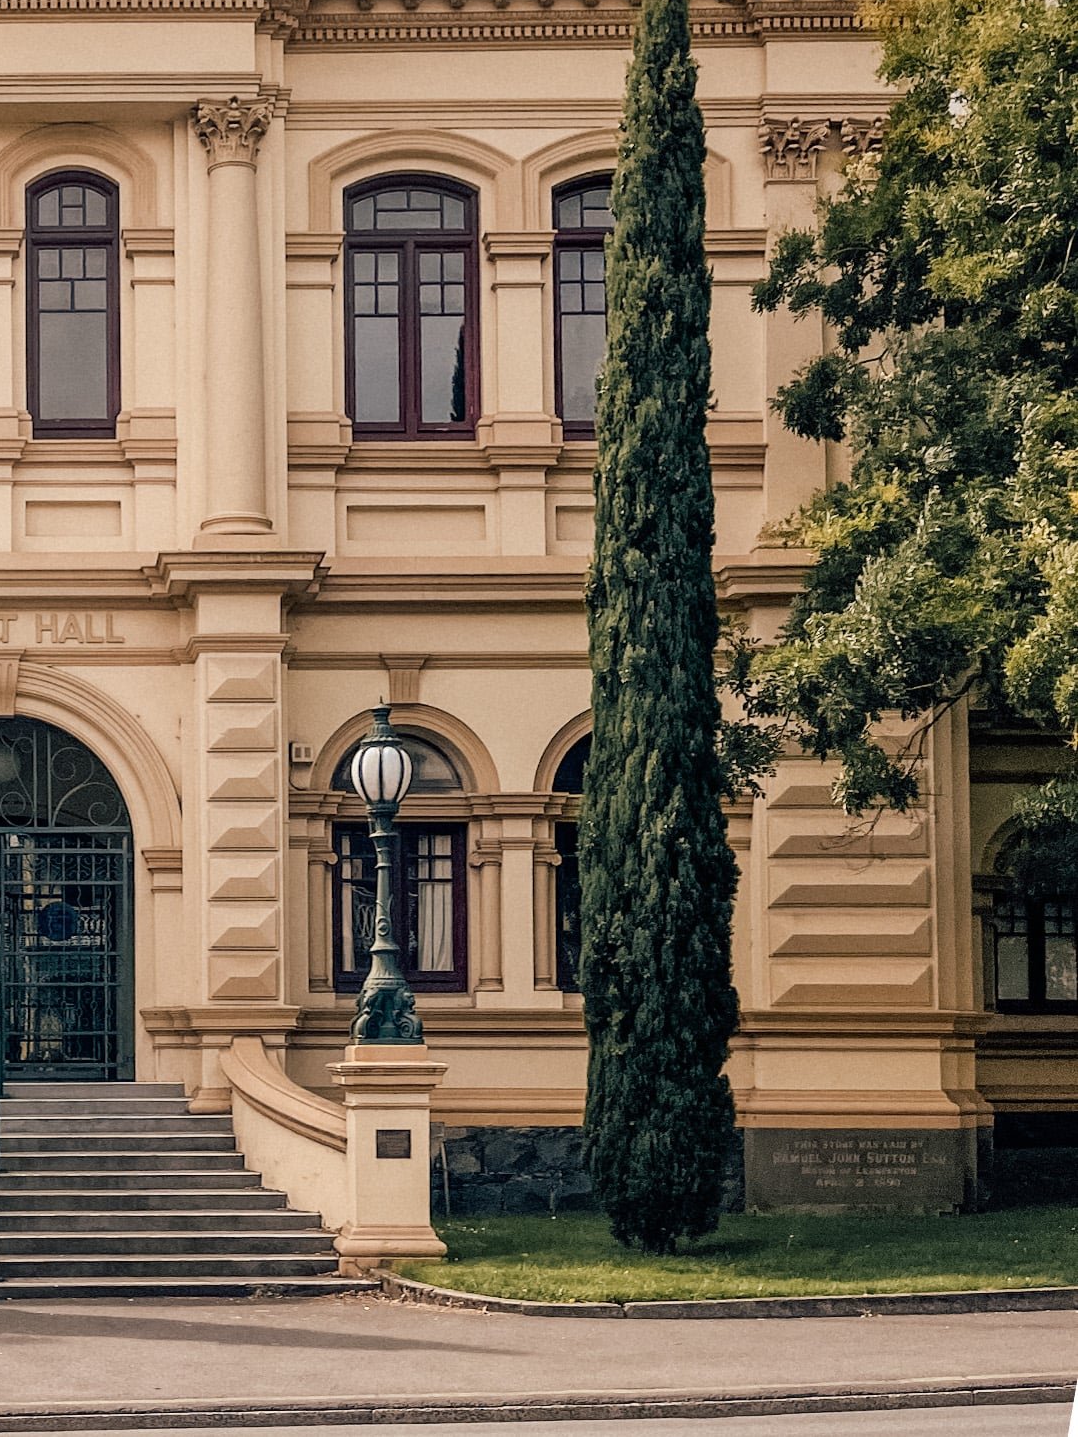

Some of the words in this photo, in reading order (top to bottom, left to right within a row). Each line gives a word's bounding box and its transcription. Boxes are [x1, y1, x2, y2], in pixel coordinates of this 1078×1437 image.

[35, 613, 126, 644] HALL
[772, 1151, 822, 1164] SAMUEL
[829, 1152, 861, 1164] JOHN
[866, 1151, 916, 1164] SUTTON
